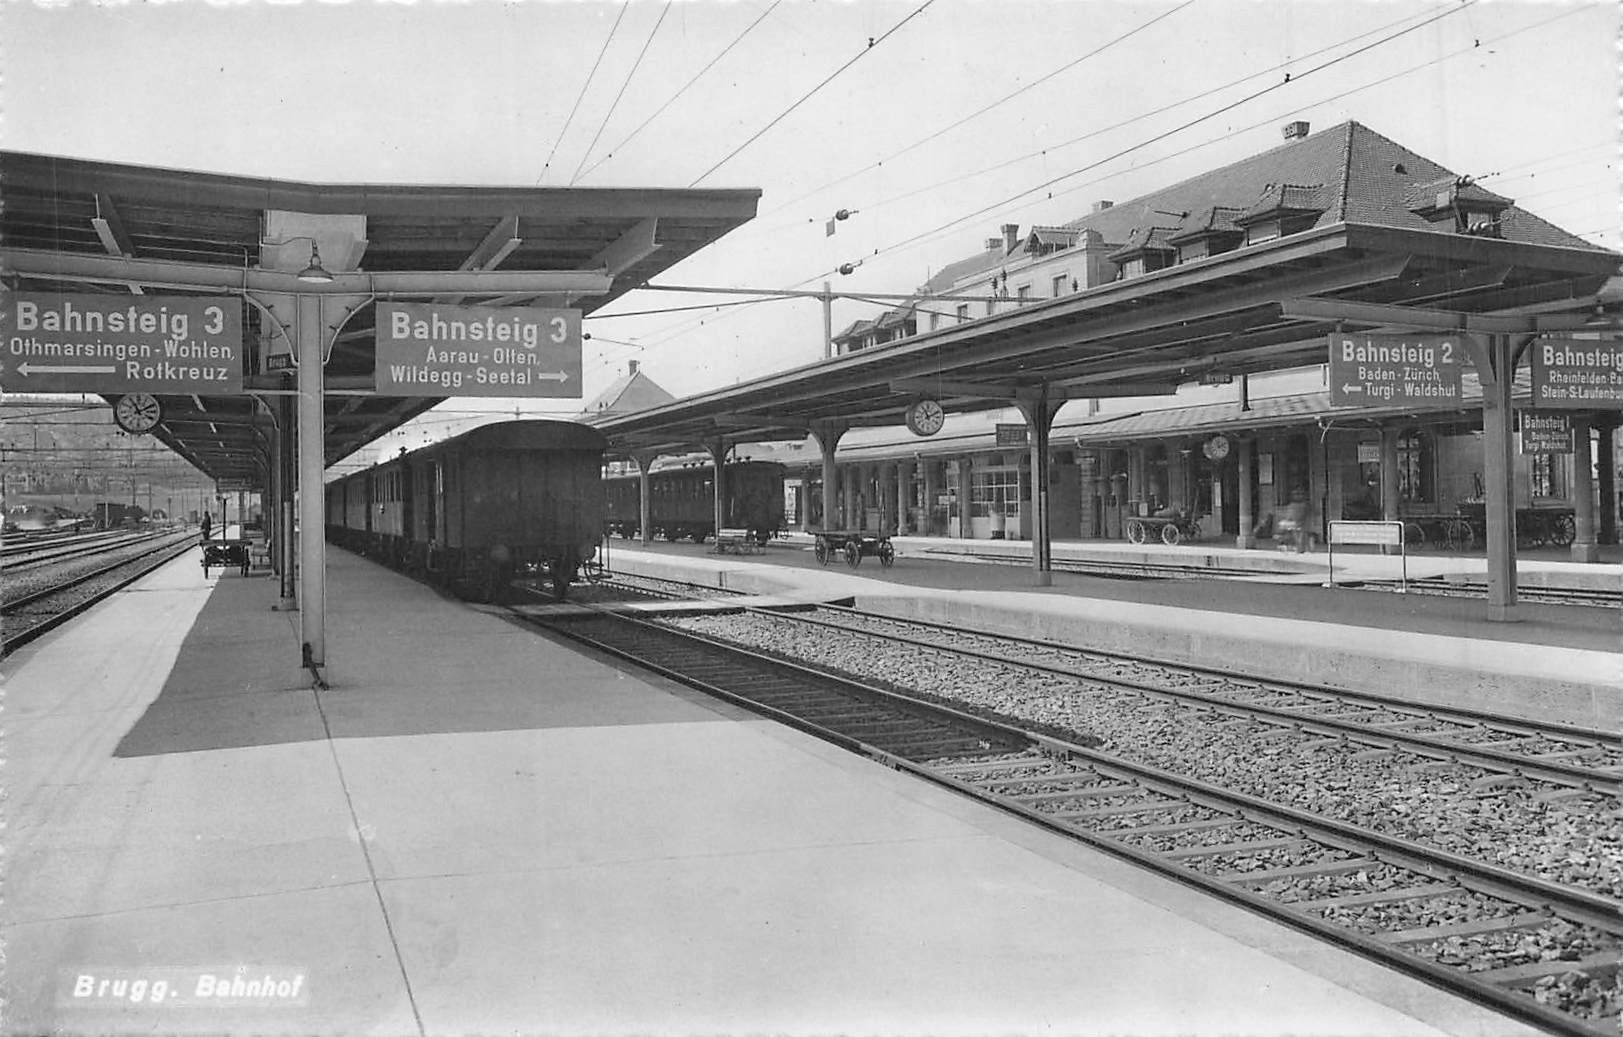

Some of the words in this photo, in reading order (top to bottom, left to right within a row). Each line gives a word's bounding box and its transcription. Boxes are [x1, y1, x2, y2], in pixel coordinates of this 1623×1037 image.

[17, 302, 188, 340] Bahnsteig
[204, 306, 224, 334] 3
[391, 311, 538, 348] Bahnsteig
[550, 317, 568, 343] 3
[1342, 340, 1434, 367] Bahnsteig
[1441, 342, 1453, 363] 2
[1543, 345, 1623, 372] Bahnsteig
[126, 361, 228, 380] Rotkreuz
[1525, 414, 1565, 432] Bahnsteig
